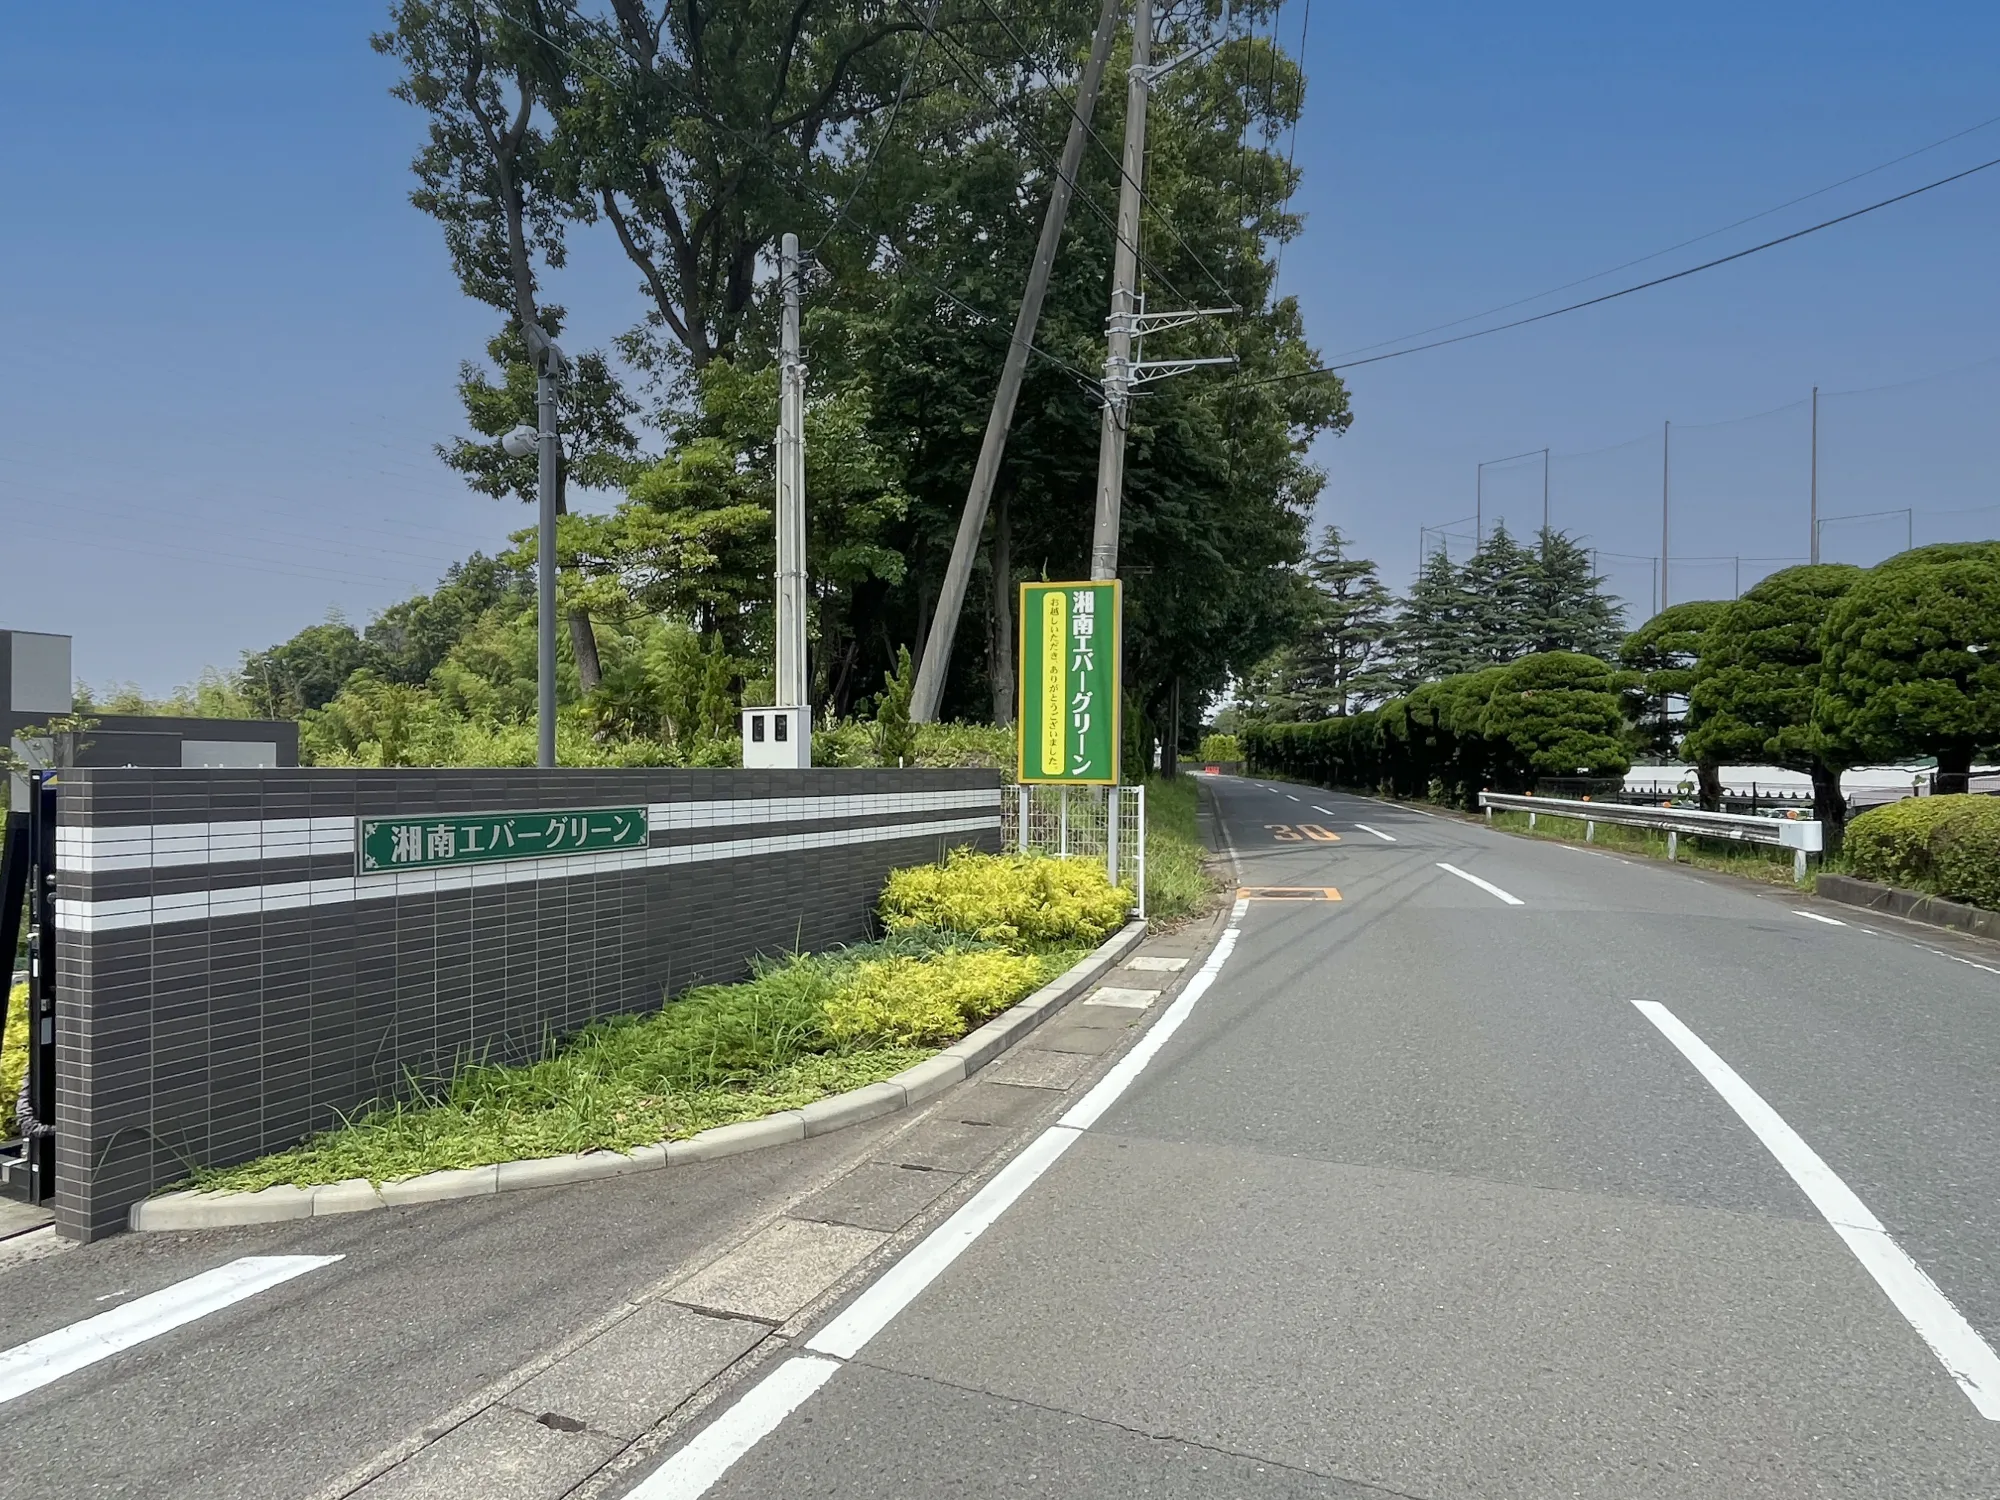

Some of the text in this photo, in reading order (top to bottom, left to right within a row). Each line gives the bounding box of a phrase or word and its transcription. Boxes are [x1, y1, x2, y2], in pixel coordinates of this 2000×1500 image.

[1048, 597, 1060, 770] お越しいただき、ありがとうございました。
[1072, 591, 1095, 776] 湘南エバーグリーン
[391, 815, 631, 862] 湘南エバーグリーン
[1264, 824, 1341, 841] 30
